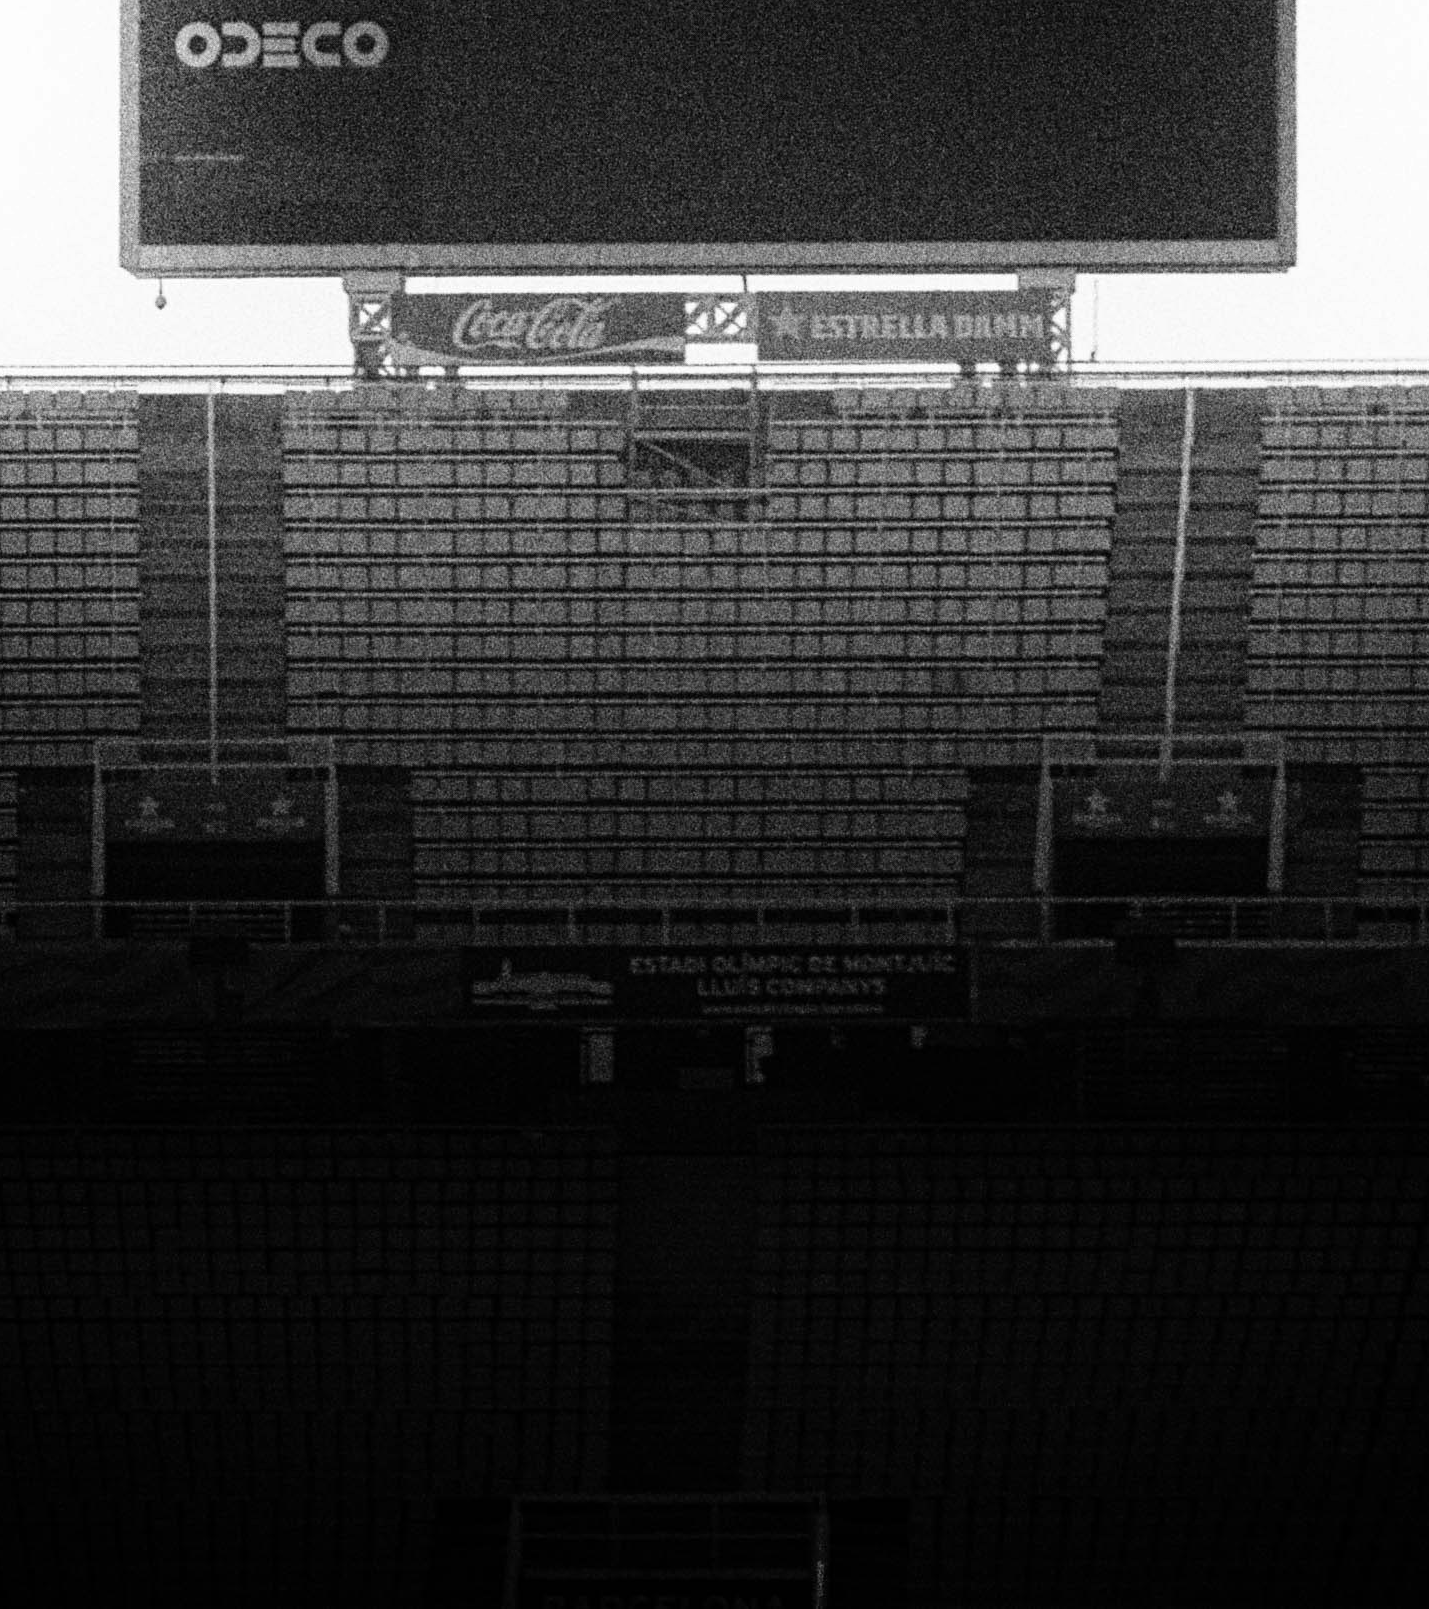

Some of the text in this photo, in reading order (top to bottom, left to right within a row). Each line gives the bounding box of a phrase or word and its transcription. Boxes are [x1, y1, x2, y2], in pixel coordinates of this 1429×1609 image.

[174, 20, 390, 68] ODECO
[810, 313, 1044, 339] ESTRELLA DAMM
[628, 955, 707, 975] ESTADI
[807, 954, 838, 974] DE
[765, 977, 887, 997] COMPANYS
